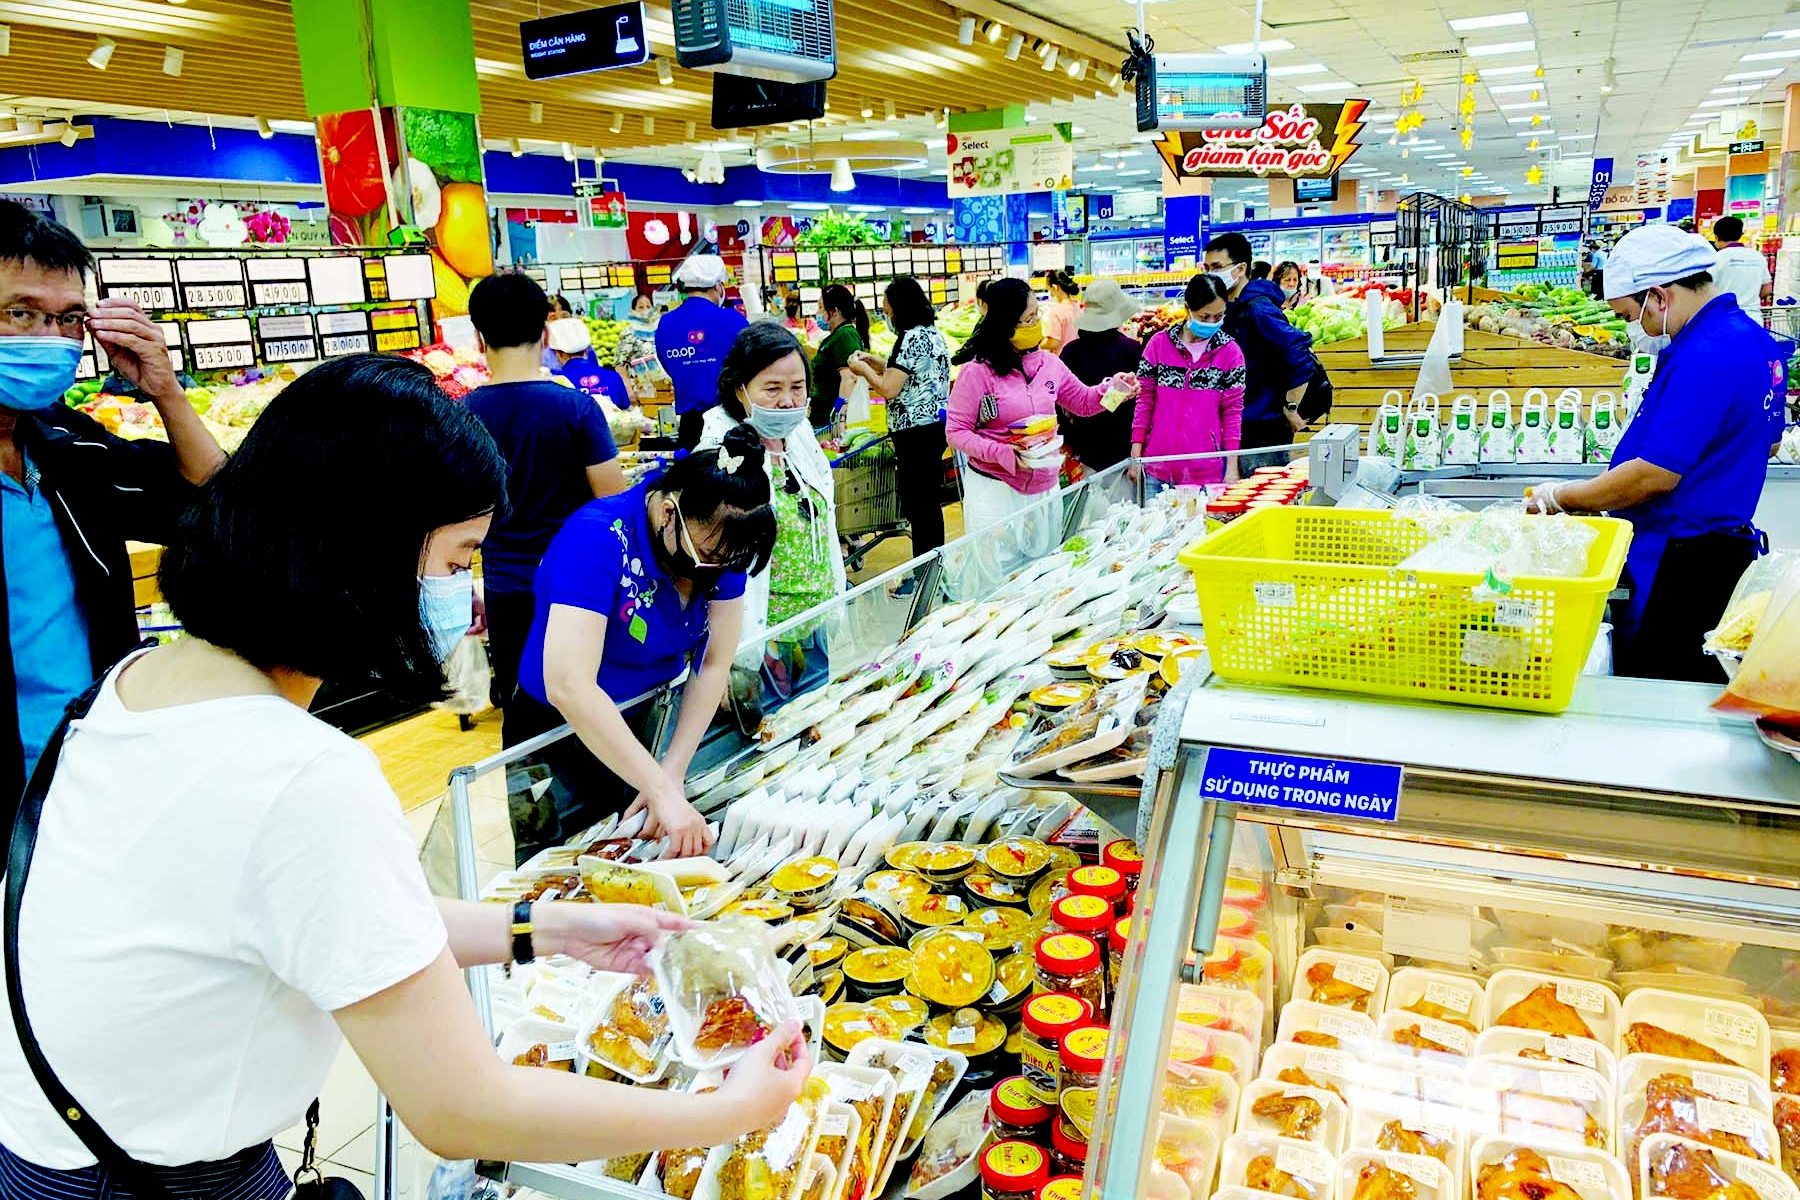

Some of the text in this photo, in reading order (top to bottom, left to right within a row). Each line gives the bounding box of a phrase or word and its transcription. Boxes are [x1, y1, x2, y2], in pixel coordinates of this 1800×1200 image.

[529, 38, 548, 50] ĐIỂM
[565, 33, 587, 44] HÀNG
[1261, 106, 1314, 139] Sốc
[962, 140, 989, 150] Select
[1187, 144, 1242, 168] giảm
[1287, 142, 1329, 171] gốc
[1595, 171, 1610, 183] 01
[1100, 207, 1112, 218] 01
[737, 223, 748, 233] 01
[1170, 235, 1195, 244] Select
[188, 288, 233, 303] 28500
[198, 346, 243, 364] 33500
[267, 340, 306, 356] 17500
[666, 346, 696, 359] co.op
[1249, 760, 1350, 784] THỰC PHẨM
[1204, 775, 1393, 813] SỬ DỤNG TRONG NGÀY
